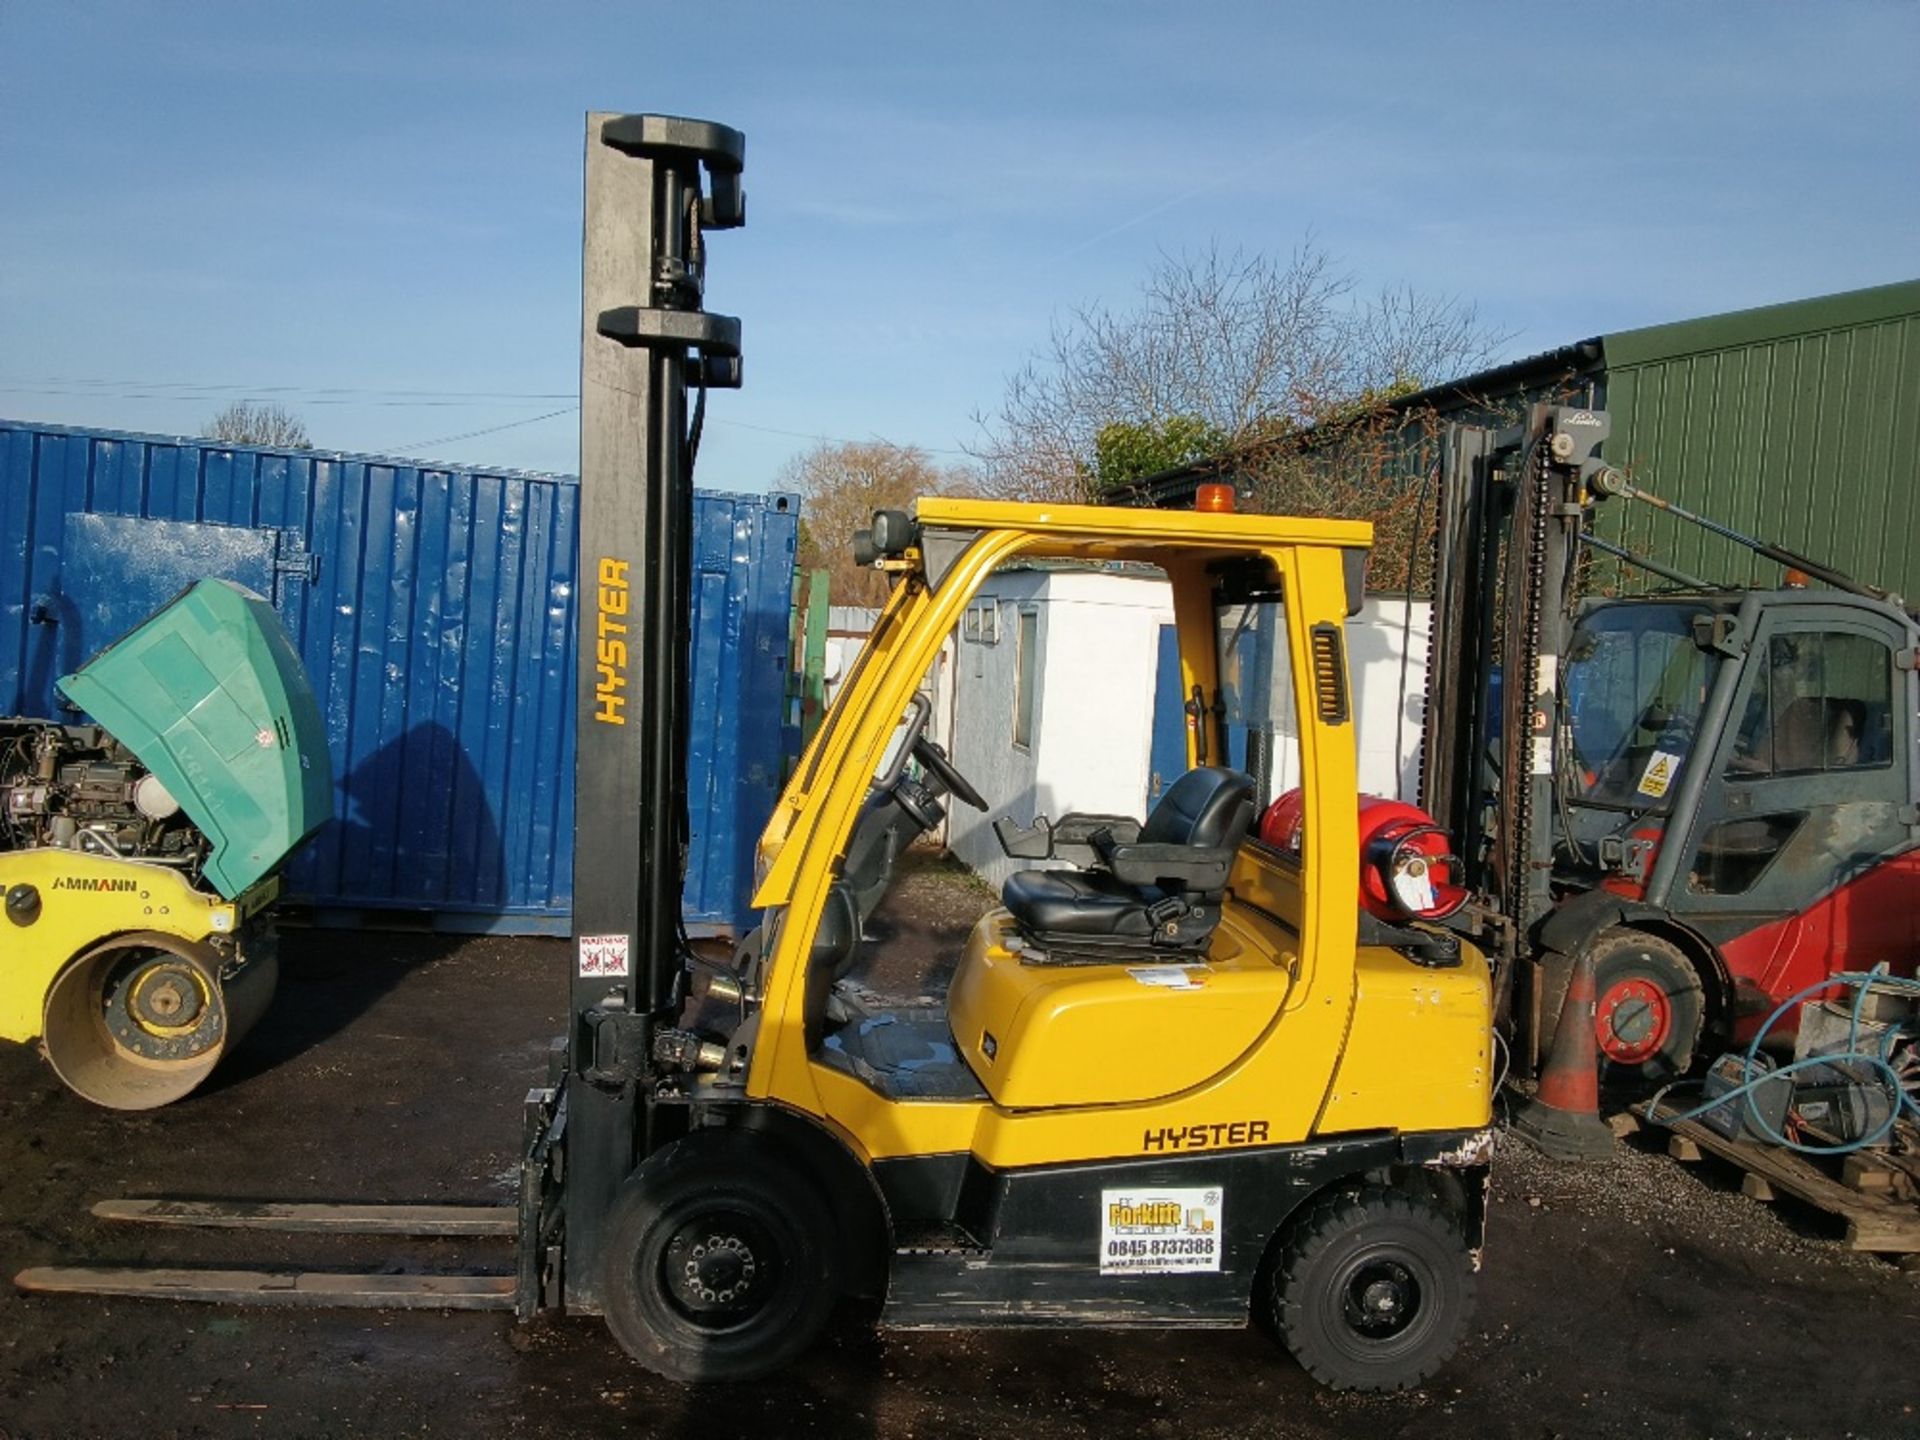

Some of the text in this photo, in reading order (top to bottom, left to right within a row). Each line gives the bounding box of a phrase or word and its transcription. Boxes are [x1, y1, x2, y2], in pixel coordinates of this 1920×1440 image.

[595, 557, 629, 725] HYSTER
[51, 877, 137, 892] AMMANN
[1143, 1120, 1270, 1151] HYSTER
[1109, 1202, 1182, 1227] Forklift
